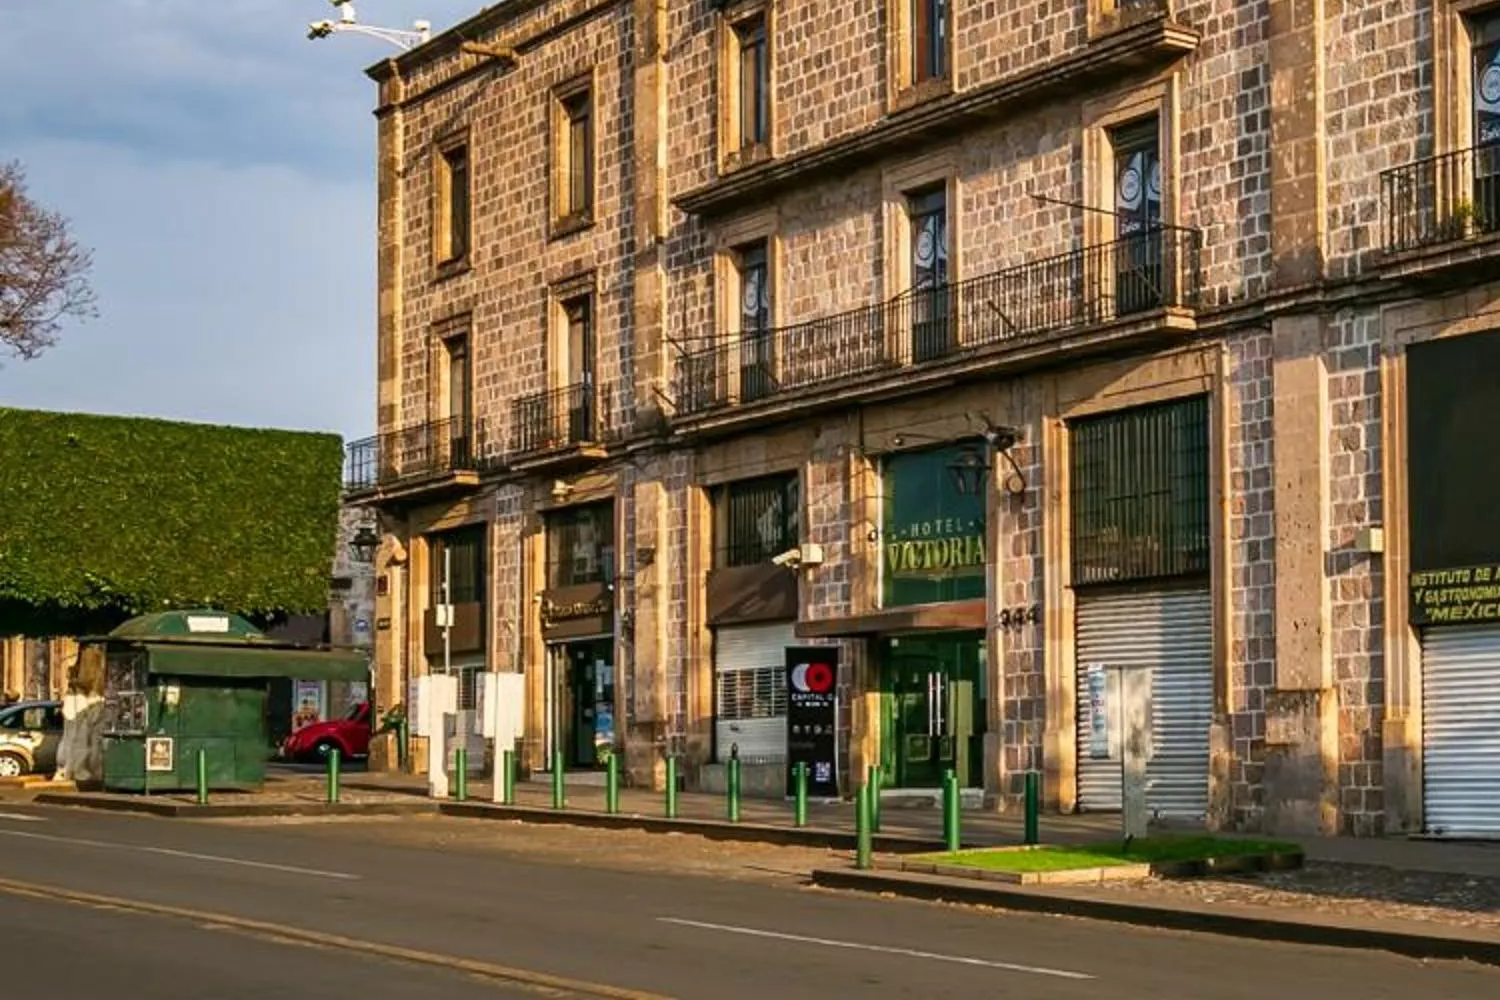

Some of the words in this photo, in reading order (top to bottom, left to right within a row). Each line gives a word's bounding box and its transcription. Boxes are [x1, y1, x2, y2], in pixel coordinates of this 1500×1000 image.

[911, 518, 962, 537] HOTEL
[887, 535, 987, 570] VICTORIA
[1412, 568, 1471, 586] INSTITUTO
[1475, 567, 1491, 582] DE
[1415, 589, 1423, 605] Y
